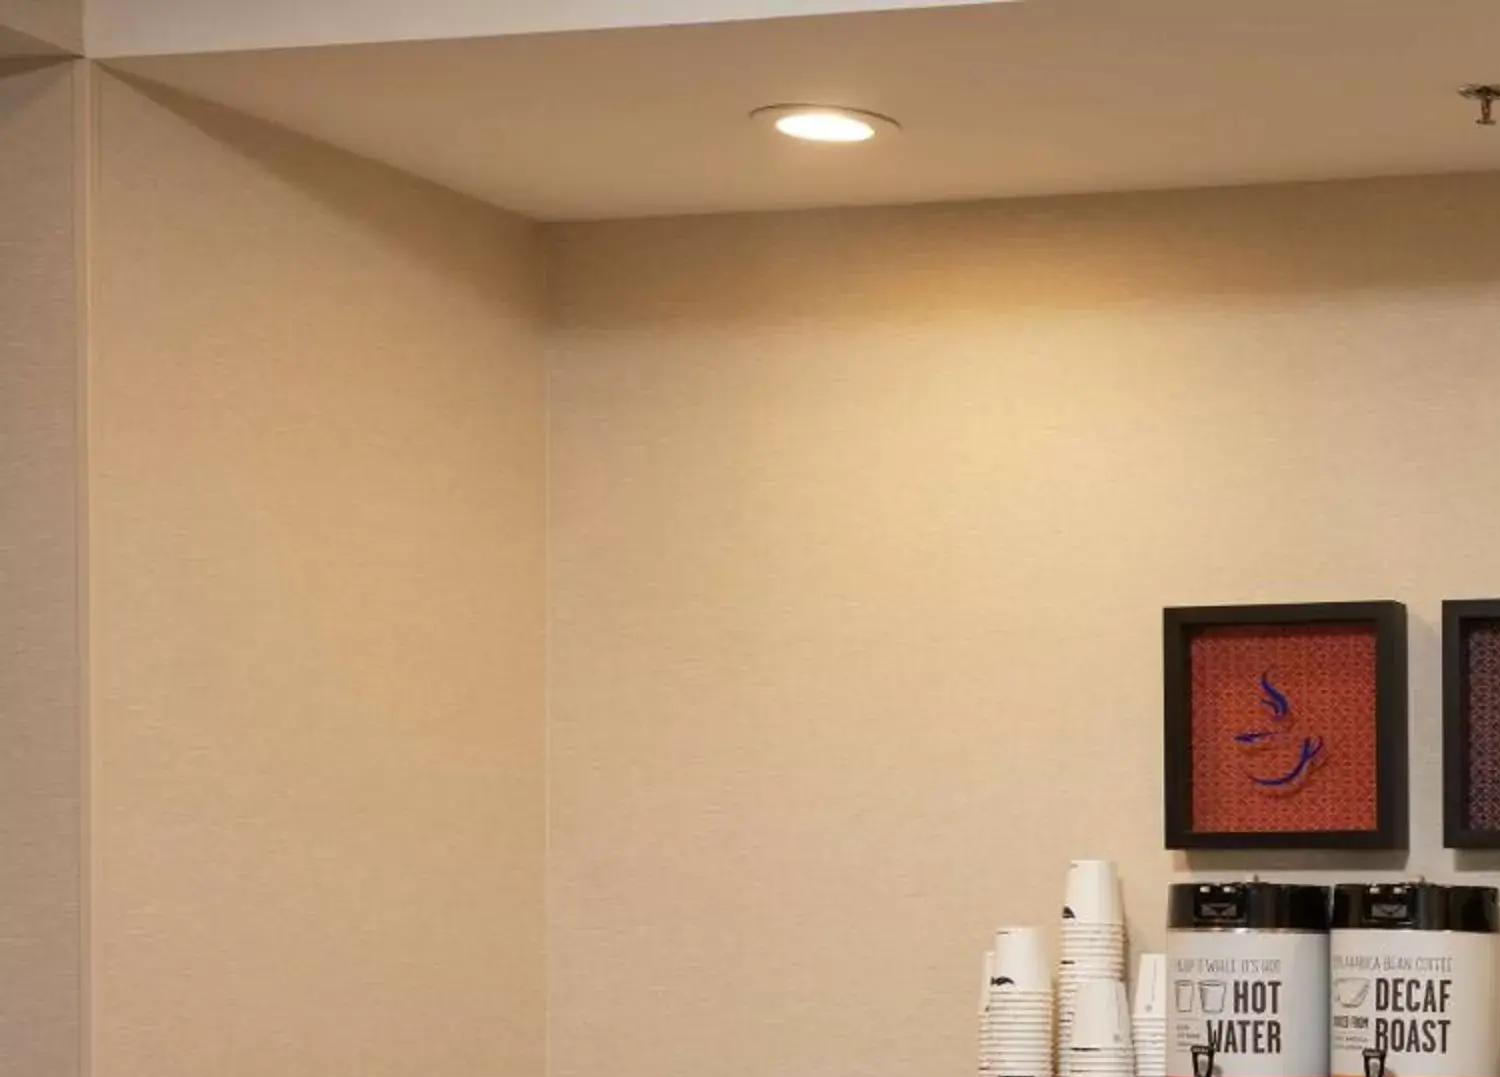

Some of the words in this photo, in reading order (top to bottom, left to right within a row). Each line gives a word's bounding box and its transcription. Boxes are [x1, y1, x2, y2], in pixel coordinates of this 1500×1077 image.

[1233, 980, 1282, 1014] HOT
[1375, 977, 1452, 1012] DECAF
[1206, 1019, 1281, 1053] WATER
[1375, 1017, 1451, 1054] ROAST
